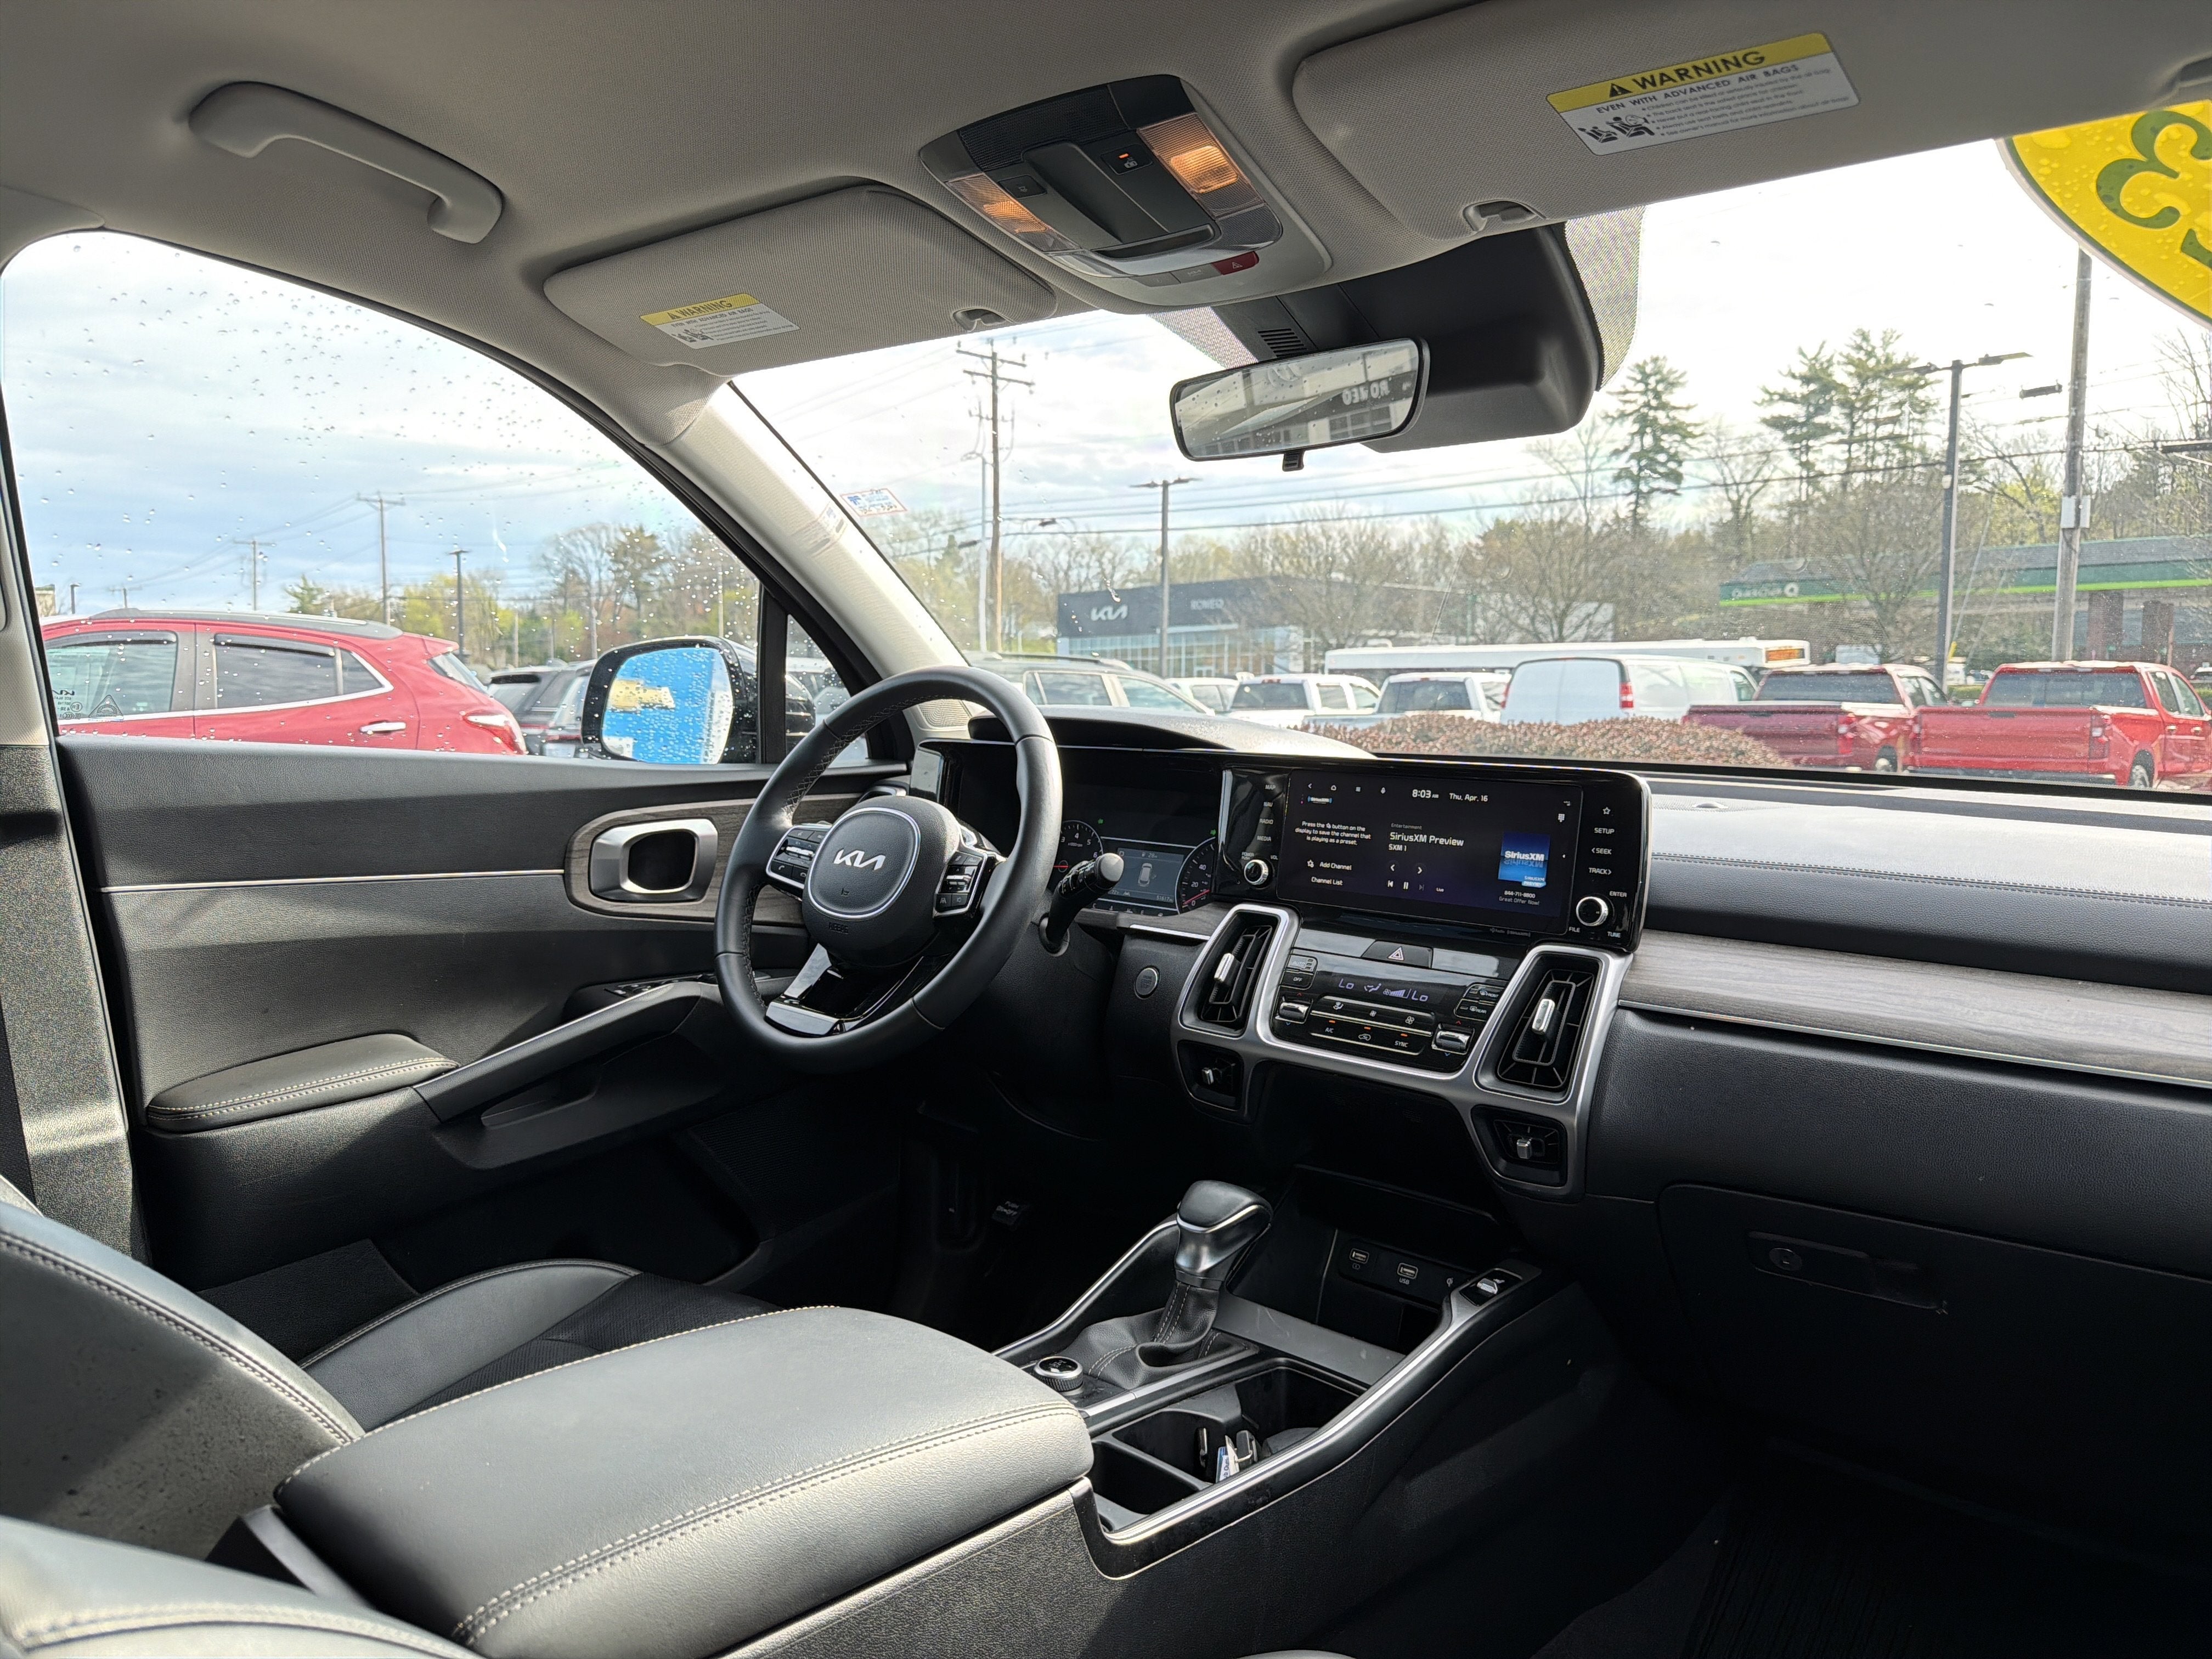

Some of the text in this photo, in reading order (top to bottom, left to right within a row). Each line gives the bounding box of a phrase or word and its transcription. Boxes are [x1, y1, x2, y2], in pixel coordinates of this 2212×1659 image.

[1632, 50, 1765, 91] WARNING
[1596, 64, 1799, 114] EVEN WITH ADVANCED AIR BAGS
[675, 300, 733, 317] WARNING
[1412, 789, 1431, 798] 8:03
[1390, 832, 1464, 847] SiriusXM Preview
[833, 849, 885, 870] KIA
[1504, 850, 1545, 861] SiriusXM
[1338, 978, 1355, 990] Lo
[1411, 990, 1429, 1002] Lo
